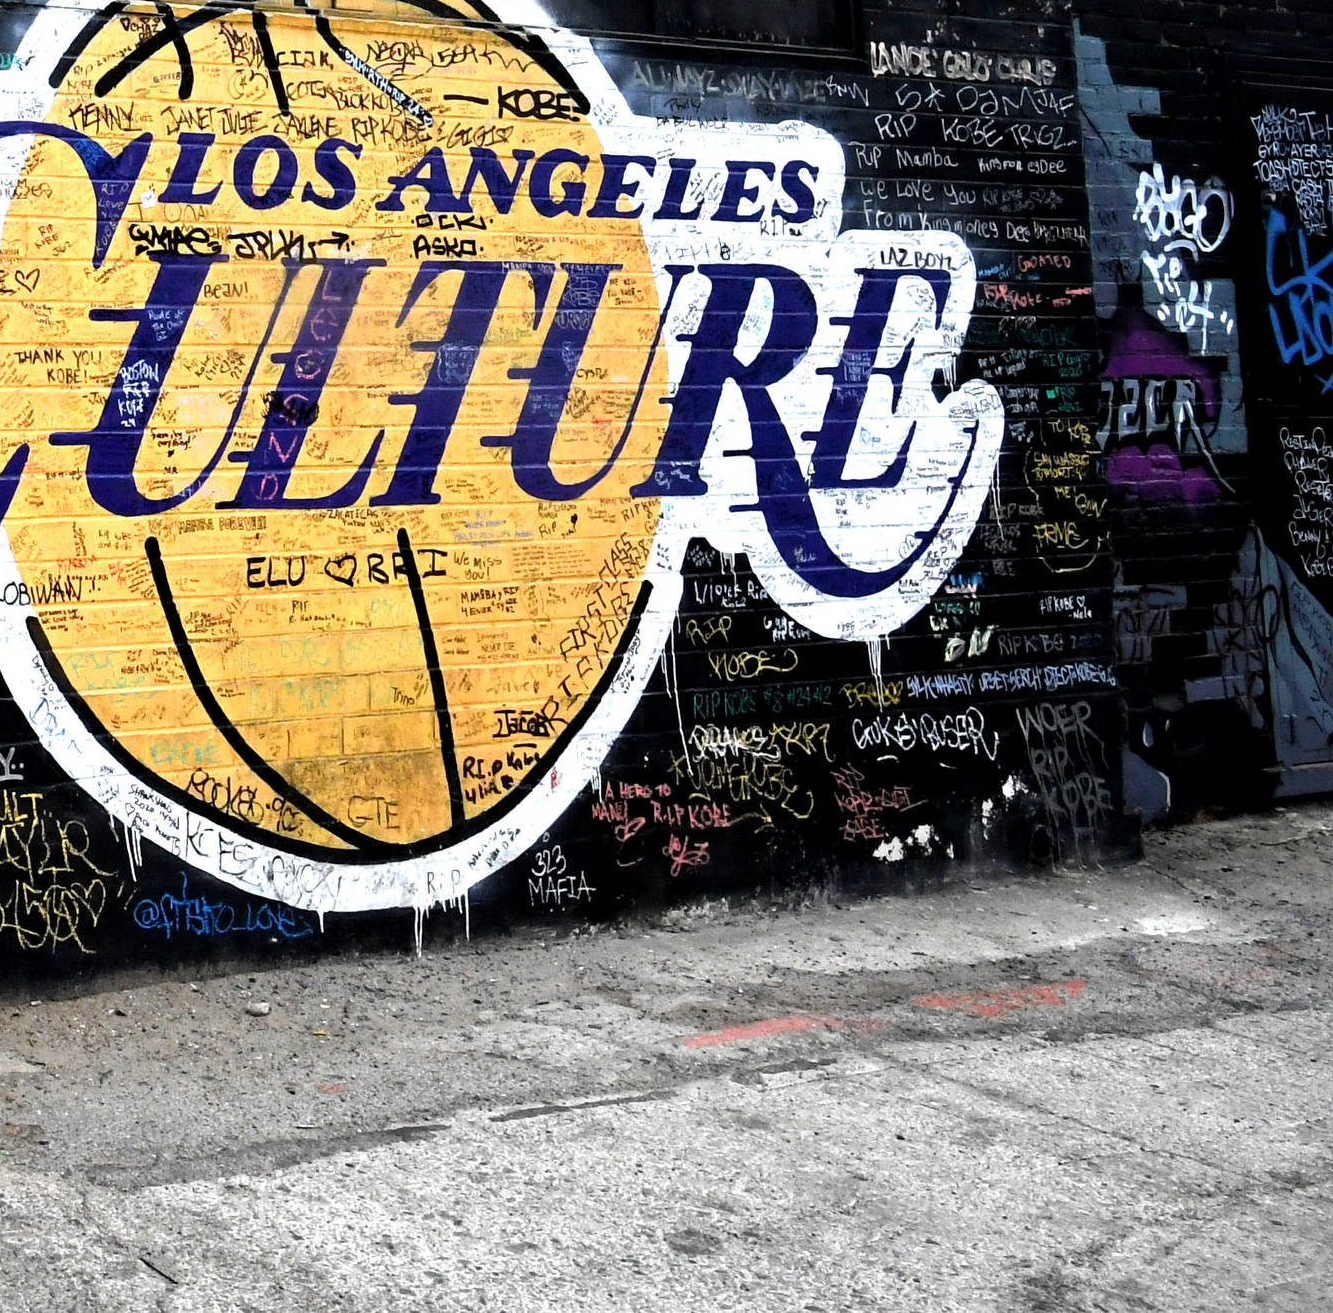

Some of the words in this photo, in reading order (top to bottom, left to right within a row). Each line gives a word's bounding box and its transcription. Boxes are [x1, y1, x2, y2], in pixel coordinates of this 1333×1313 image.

[874, 114, 917, 140] RIP
[942, 117, 1003, 147] KOBE
[157, 133, 362, 210] LOS
[375, 133, 821, 222] ANGELES
[14, 348, 64, 365] THANK
[73, 349, 102, 367] YOU
[247, 556, 306, 587] ELU
[693, 692, 720, 718] RIP
[348, 795, 400, 829] GTE
[532, 845, 566, 876] 323
[528, 872, 597, 907] MAFIA
